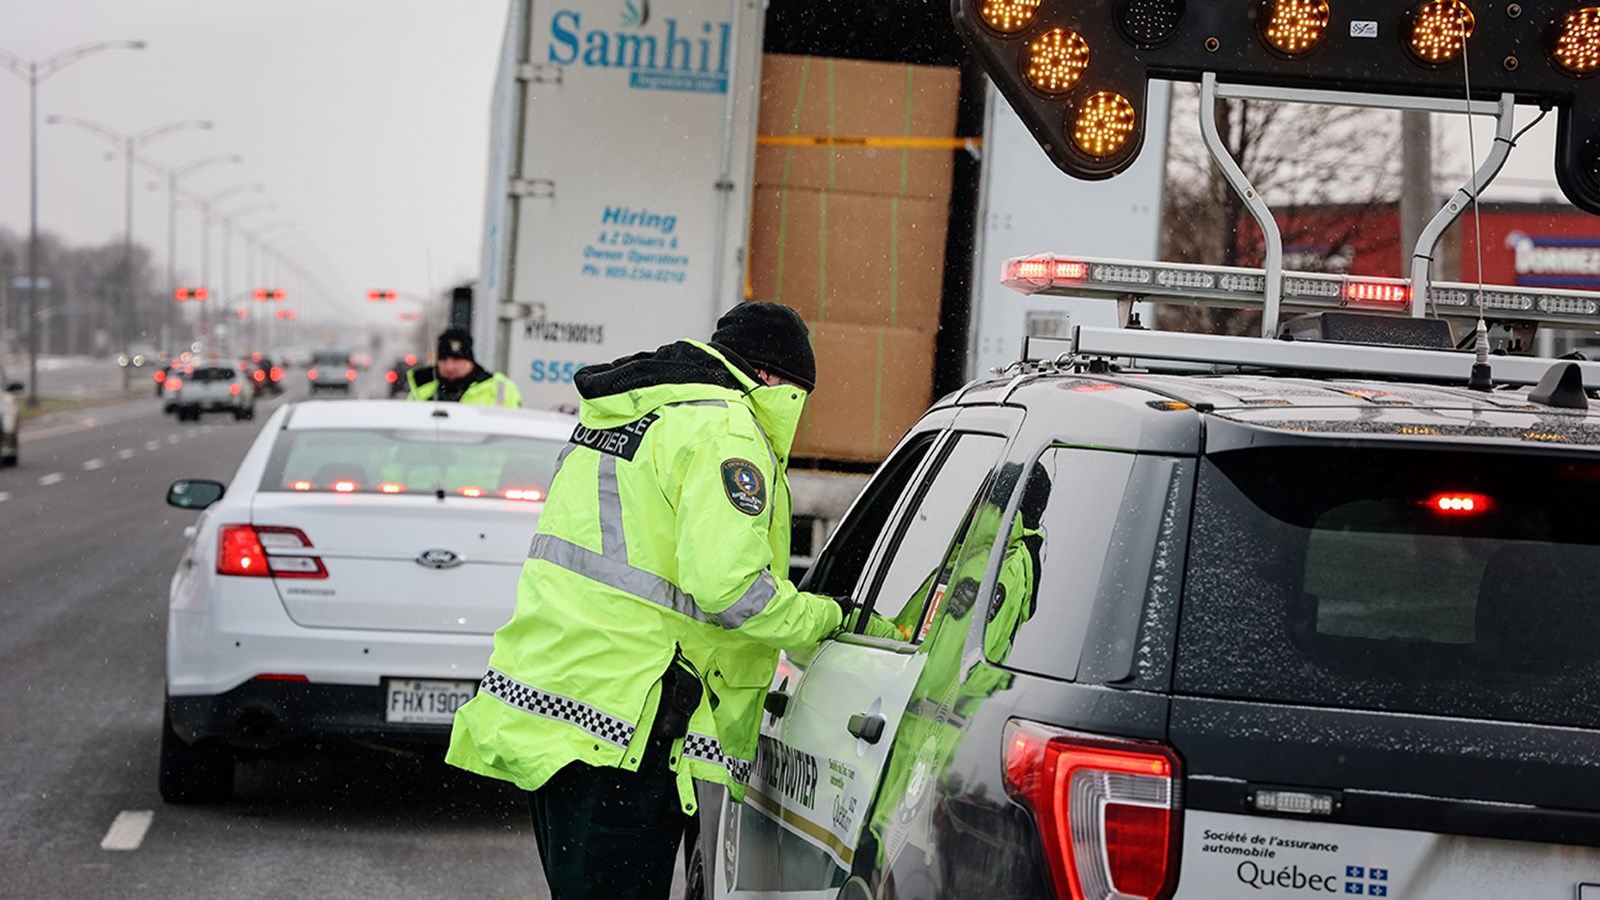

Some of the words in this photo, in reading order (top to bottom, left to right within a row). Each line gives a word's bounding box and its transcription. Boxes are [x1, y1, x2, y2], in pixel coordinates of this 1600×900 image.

[549, 9, 730, 74] Samhil
[602, 206, 677, 235] Hiring
[573, 425, 629, 454] OUTIER
[1202, 829, 1248, 844] Société
[1250, 834, 1267, 846] de
[1268, 836, 1339, 852] l'assurance
[1202, 843, 1276, 859] automobile
[1236, 860, 1338, 893] Québec
